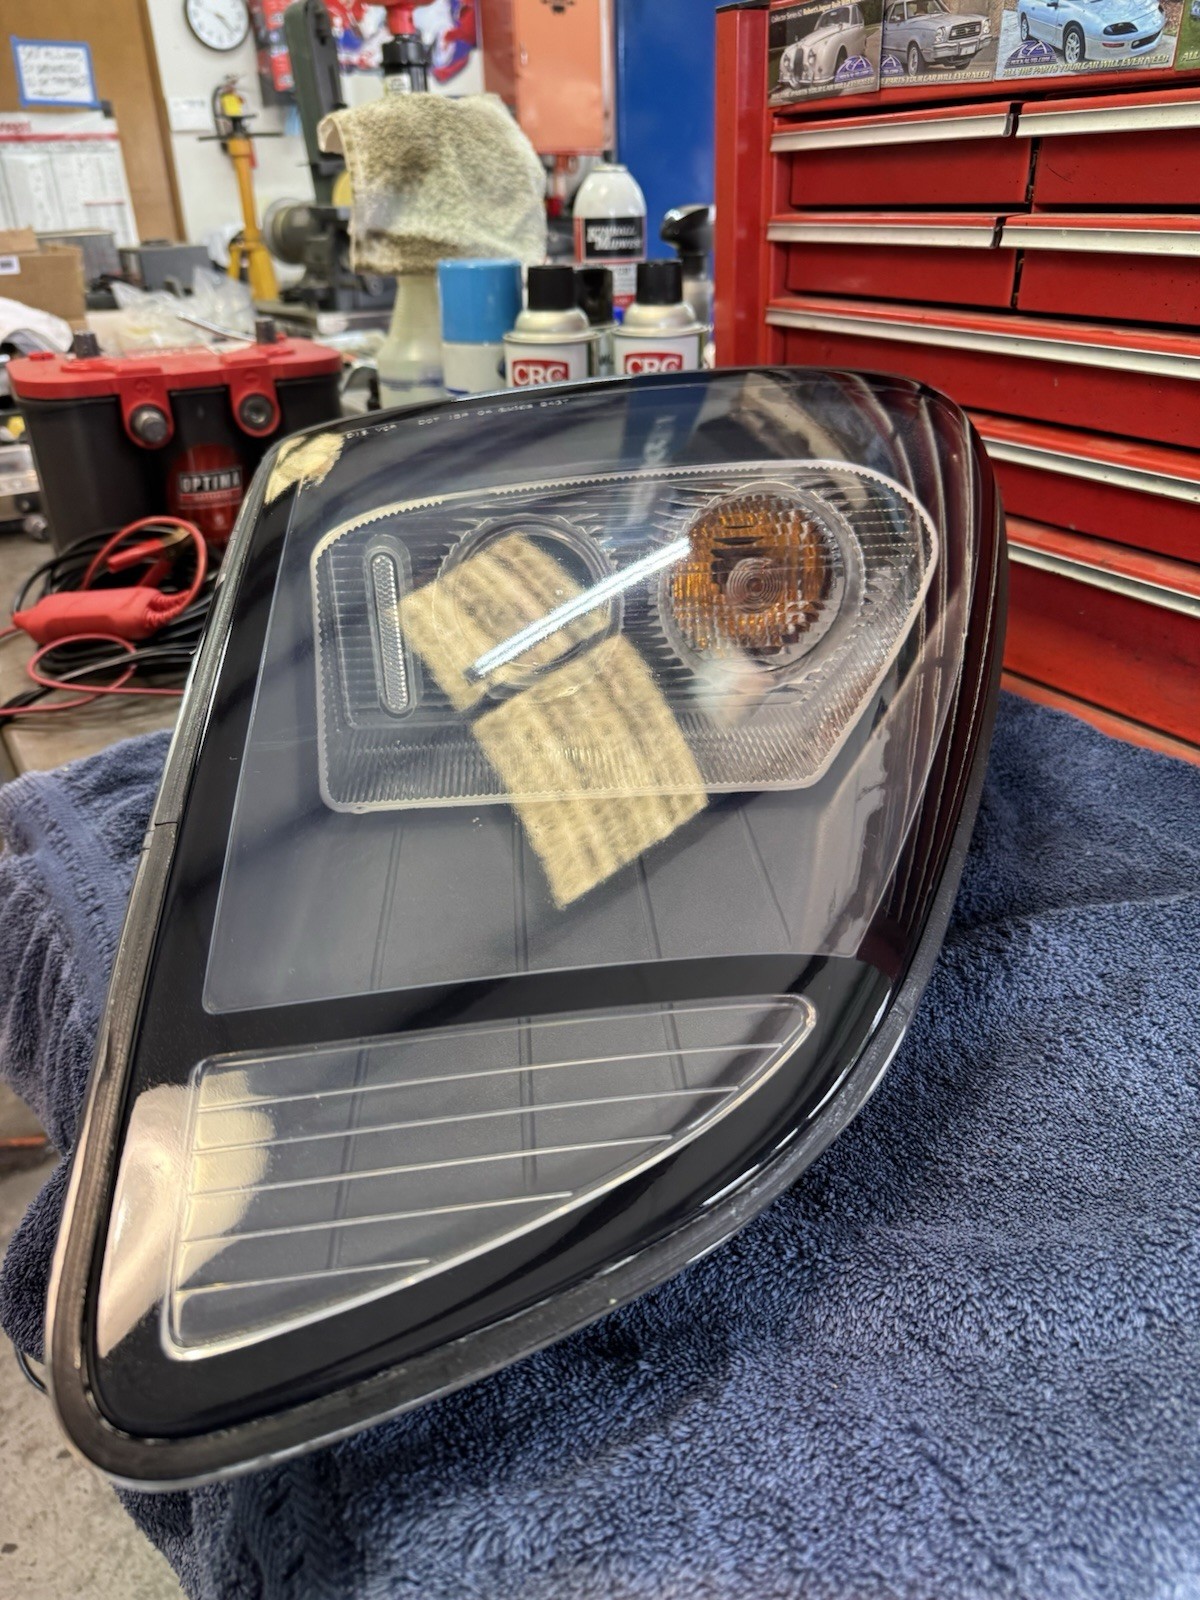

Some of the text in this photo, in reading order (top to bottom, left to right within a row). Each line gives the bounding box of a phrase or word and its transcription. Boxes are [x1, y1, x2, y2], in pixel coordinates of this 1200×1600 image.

[1003, 55, 1169, 76] ALL THE PARTS YOUR CAR WILL EVER NEED
[1181, 51, 1199, 61] ALL
[905, 75, 924, 83] YOUR
[923, 74, 937, 82] CAR
[936, 73, 952, 81] WILL
[953, 72, 972, 80] EVER
[971, 70, 990, 79] NEED
[513, 364, 566, 387] CRC
[182, 471, 240, 493] OPTIMA
